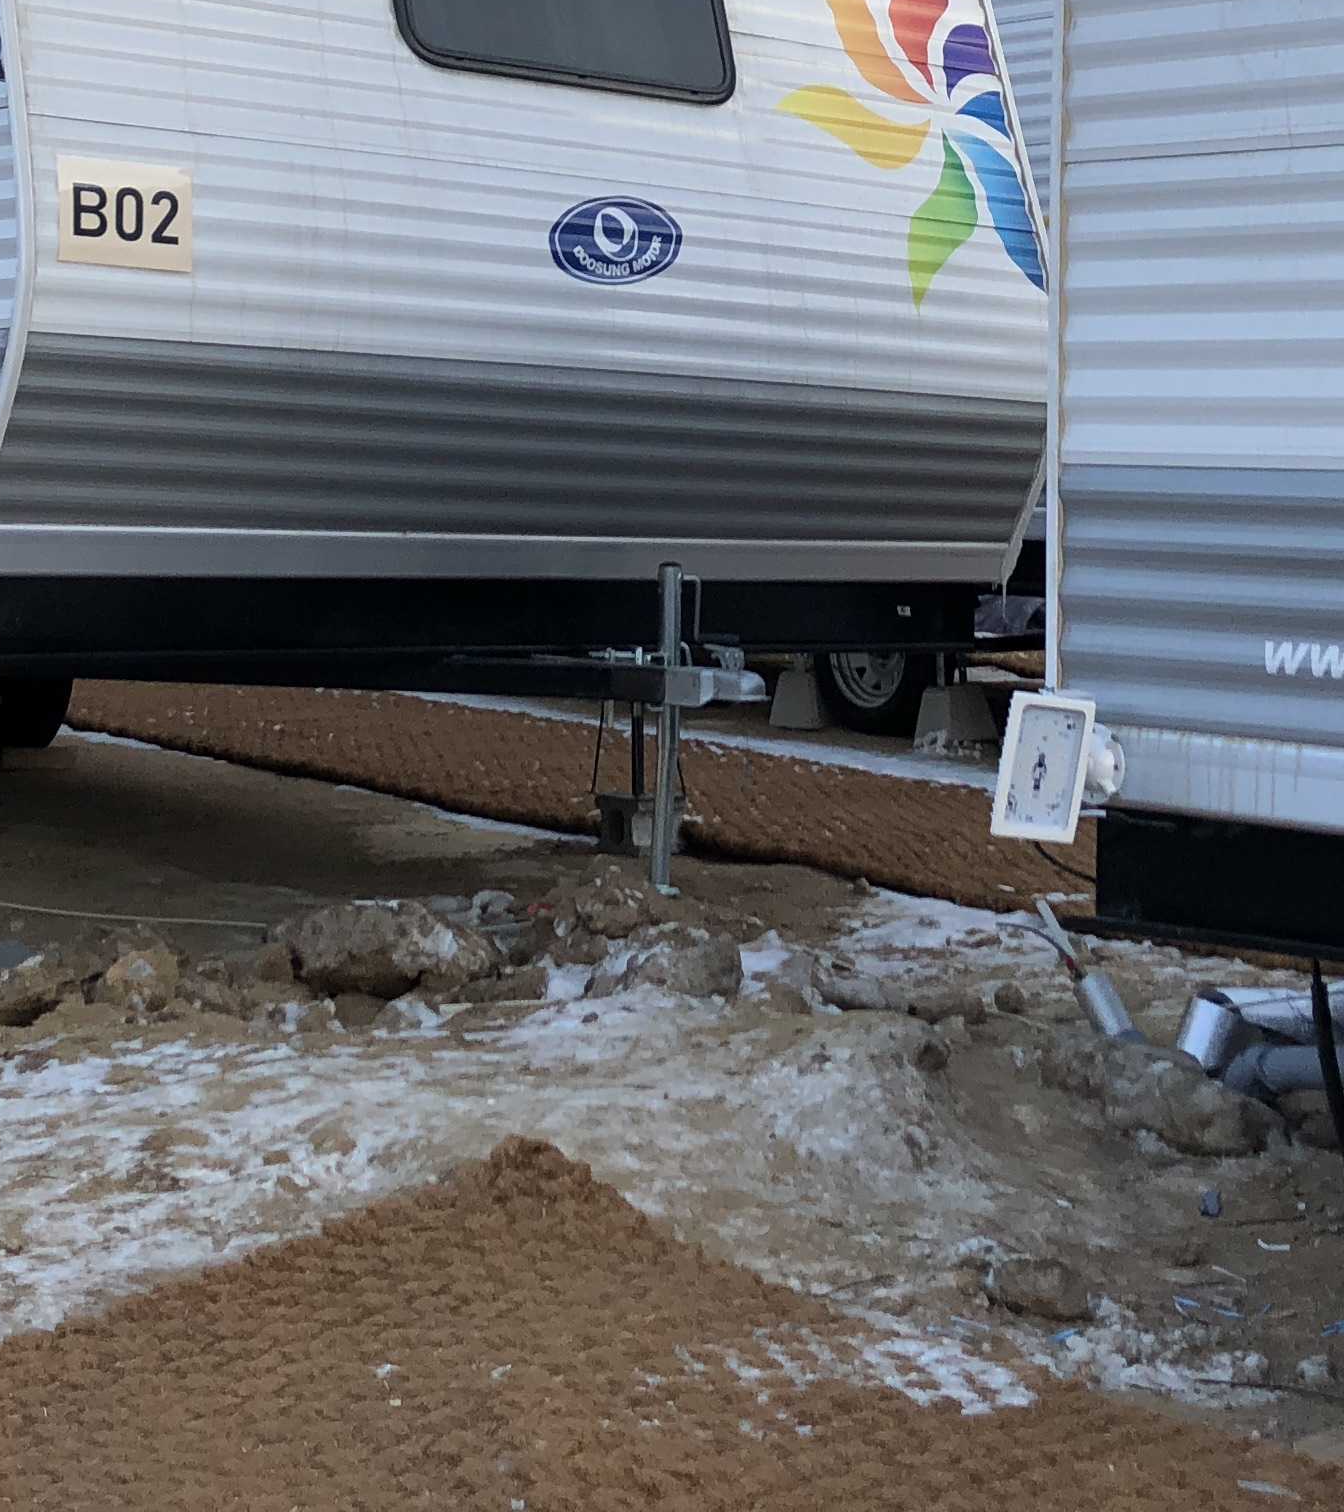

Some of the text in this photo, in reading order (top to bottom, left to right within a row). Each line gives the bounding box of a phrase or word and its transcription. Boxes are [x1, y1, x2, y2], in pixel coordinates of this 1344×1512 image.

[72, 182, 179, 246] B02
[573, 234, 663, 277] DOOSUNG MOTOR
